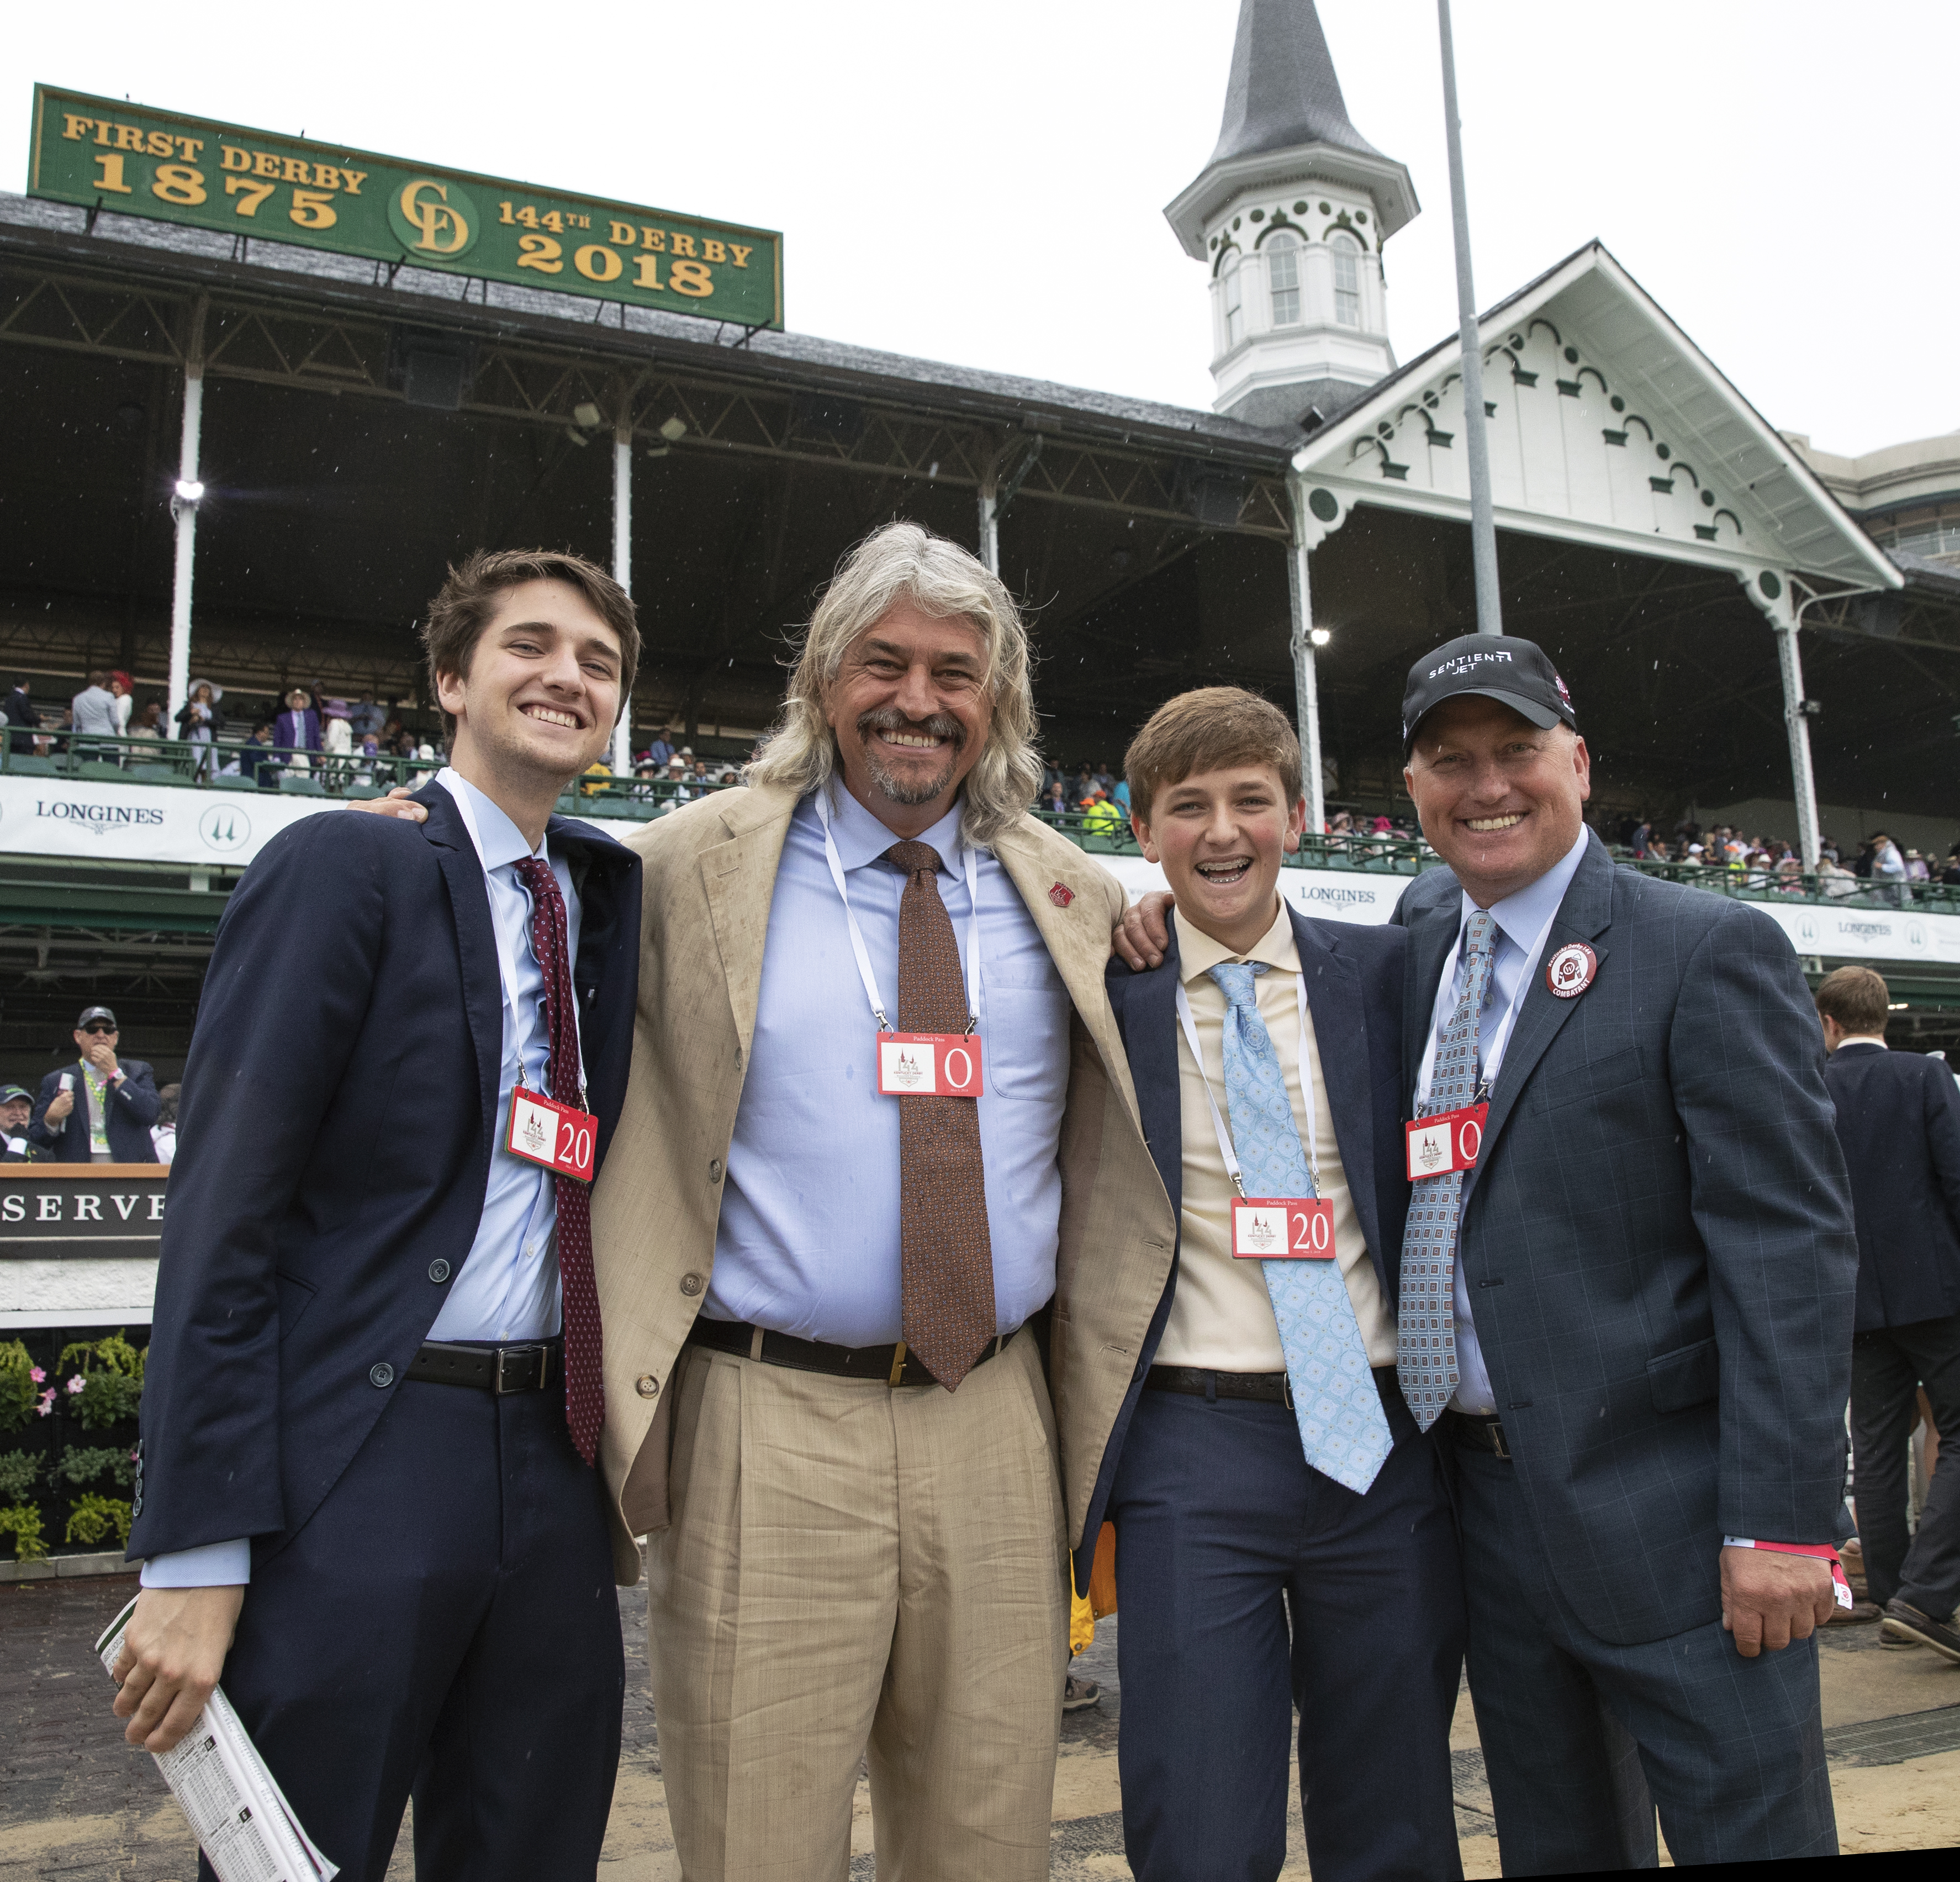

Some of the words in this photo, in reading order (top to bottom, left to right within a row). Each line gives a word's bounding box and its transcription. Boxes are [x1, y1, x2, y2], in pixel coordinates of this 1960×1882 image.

[62, 113, 203, 162] FIRST
[220, 145, 367, 194] DERBY
[93, 153, 337, 229] 1875
[609, 220, 753, 268] DERBY
[517, 234, 714, 297] 2018
[1429, 652, 1505, 679] SENTIENT
[1452, 662, 1477, 676] JET
[36, 800, 163, 825] LONGINES
[1301, 886, 1375, 903] LONGINES
[1838, 921, 1892, 936] LONGINES
[1548, 945, 1567, 967] Kentucky
[1583, 946, 1592, 955] 144
[1552, 978, 1590, 998] COMBATANT
[543, 1100, 560, 1110] Paddock
[1434, 1115, 1450, 1123] Paddock
[558, 1122, 591, 1169] 20
[1292, 1213, 1329, 1250] 20
